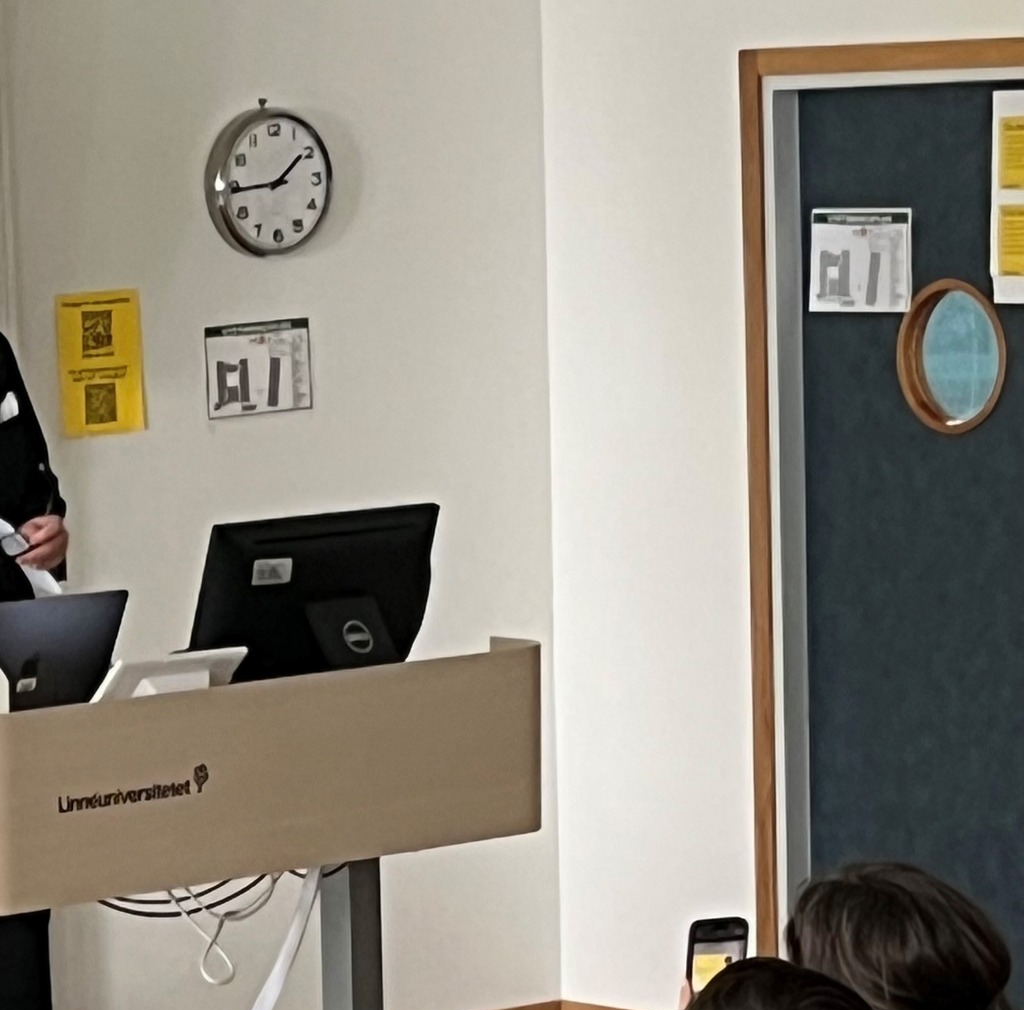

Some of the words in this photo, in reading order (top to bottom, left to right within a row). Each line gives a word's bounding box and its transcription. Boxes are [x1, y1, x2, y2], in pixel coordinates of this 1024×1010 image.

[303, 145, 314, 159] 2
[310, 171, 322, 186] 3
[254, 223, 262, 238] 7
